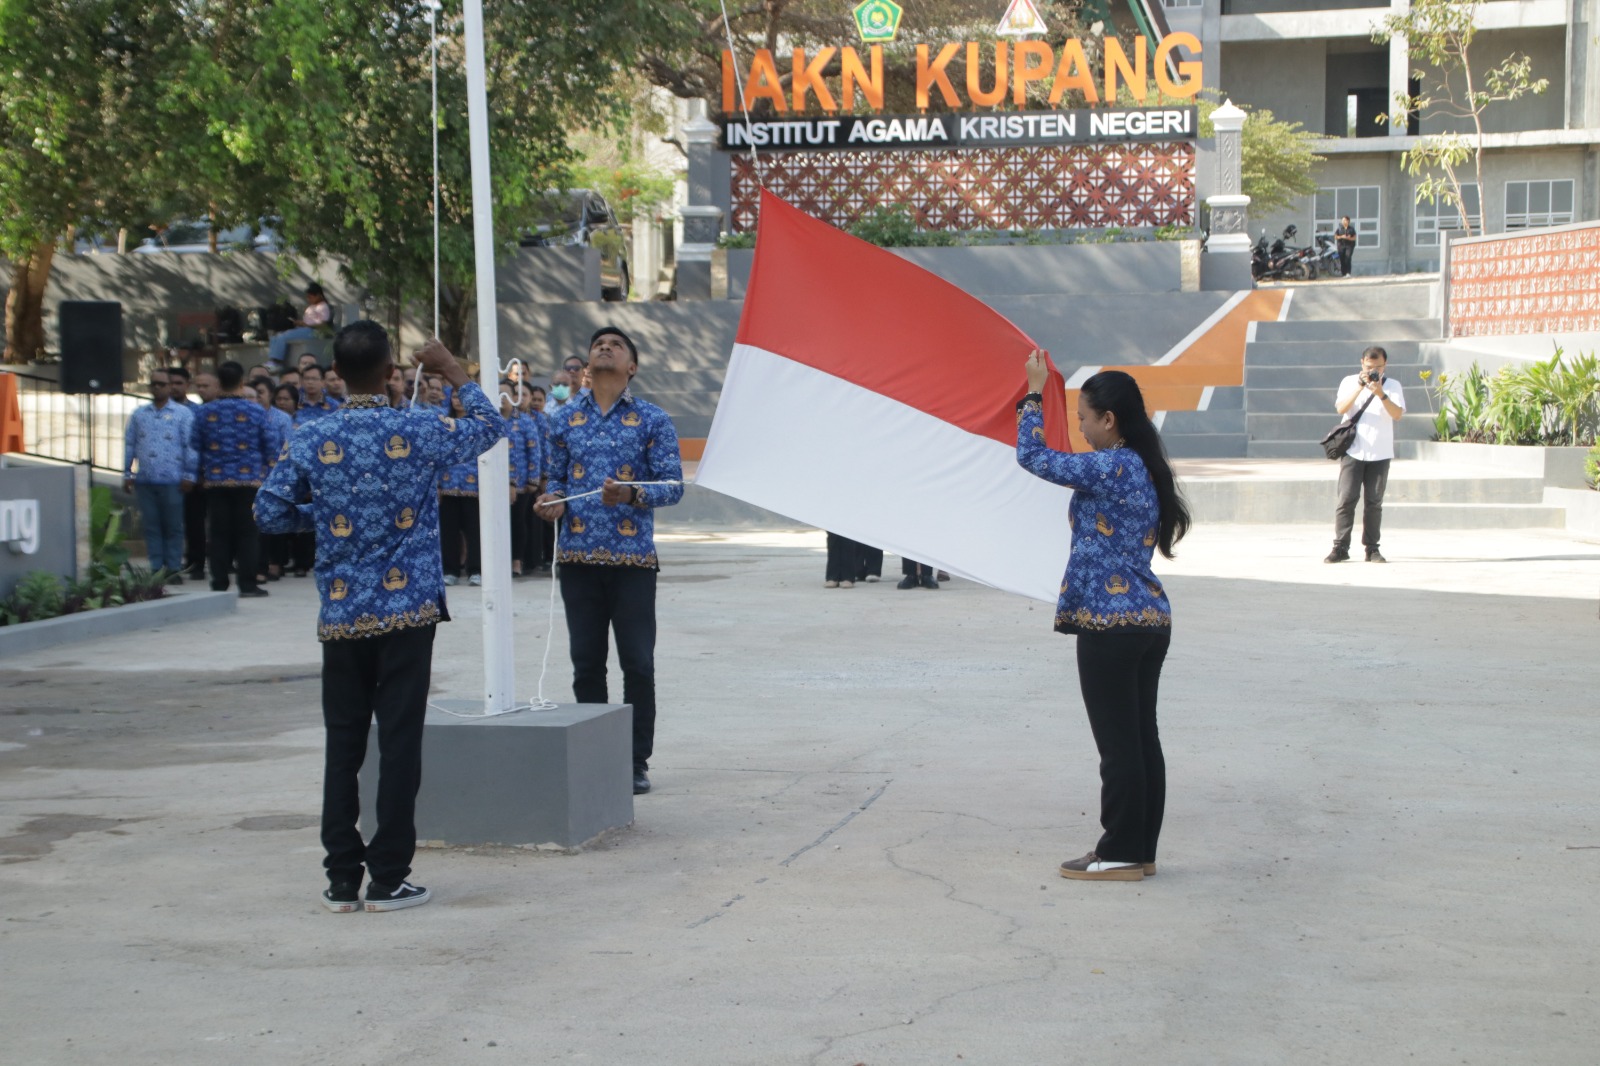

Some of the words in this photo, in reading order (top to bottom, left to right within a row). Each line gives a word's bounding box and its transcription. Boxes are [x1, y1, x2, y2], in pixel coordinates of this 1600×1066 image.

[722, 45, 884, 112] IAKN
[916, 31, 1203, 108] KUPANG
[726, 120, 841, 145] INSTITUT
[848, 118, 948, 143] AGAMA
[960, 113, 1076, 139] KRISTEN
[1090, 110, 1191, 136] NEGERI
